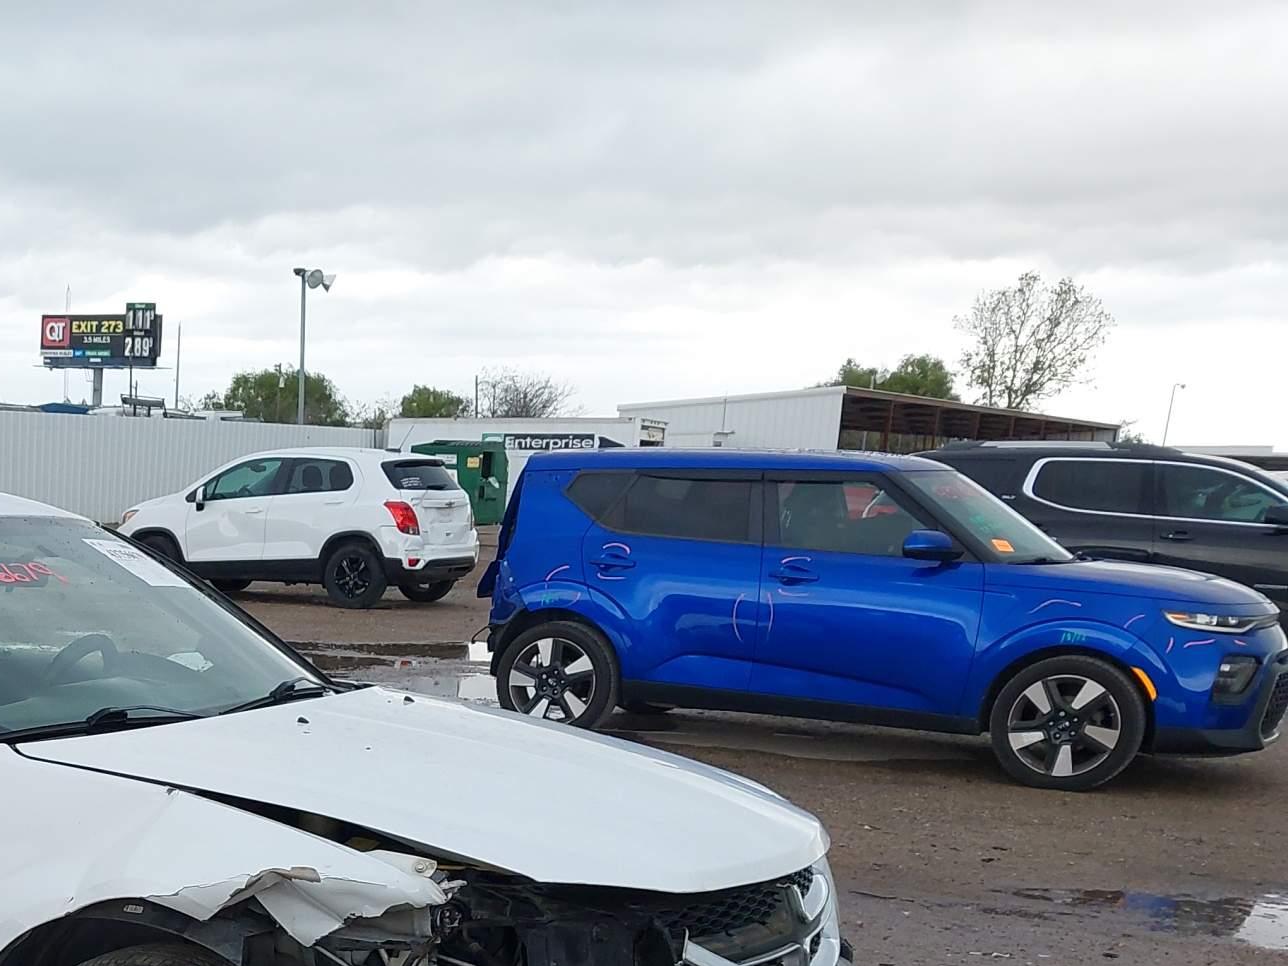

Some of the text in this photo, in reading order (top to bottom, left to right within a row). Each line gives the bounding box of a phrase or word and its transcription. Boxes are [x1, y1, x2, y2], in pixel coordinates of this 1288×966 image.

[45, 322, 66, 342] QT
[72, 320, 98, 333] EXIT
[101, 320, 123, 333] 273
[93, 336, 111, 344] MILES
[504, 434, 593, 453] Enterprise
